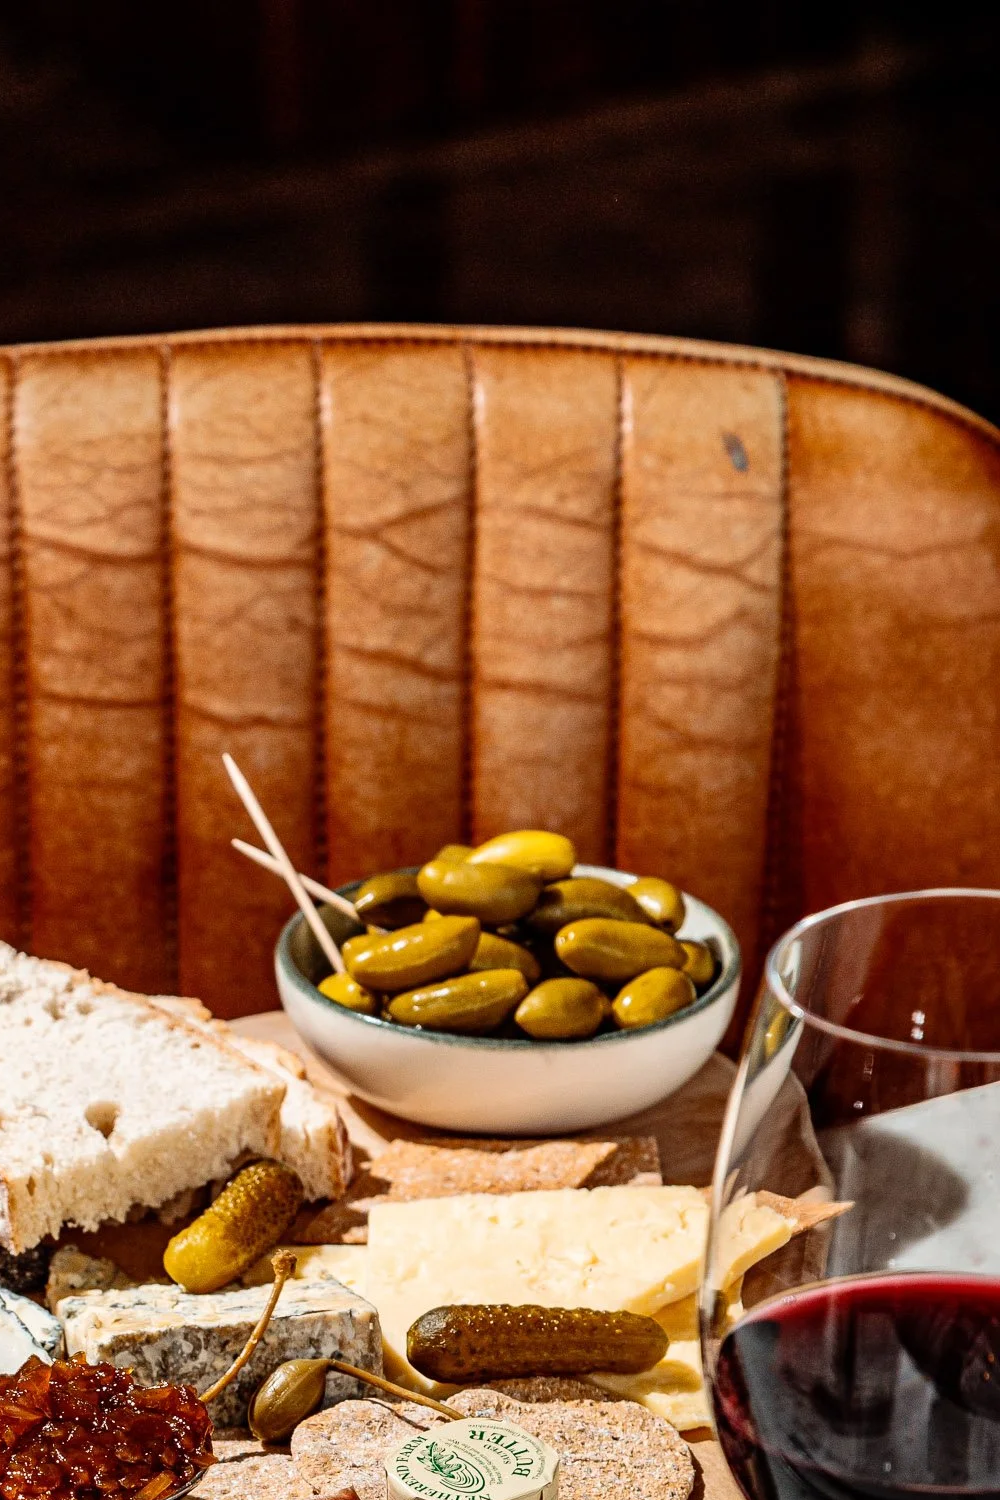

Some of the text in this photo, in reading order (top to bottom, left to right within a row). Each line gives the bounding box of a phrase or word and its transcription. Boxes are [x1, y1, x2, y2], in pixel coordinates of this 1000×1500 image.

[396, 1435, 427, 1463] FARM
[469, 1429, 533, 1478] BUTTER
[483, 1444, 511, 1465] SALTED
